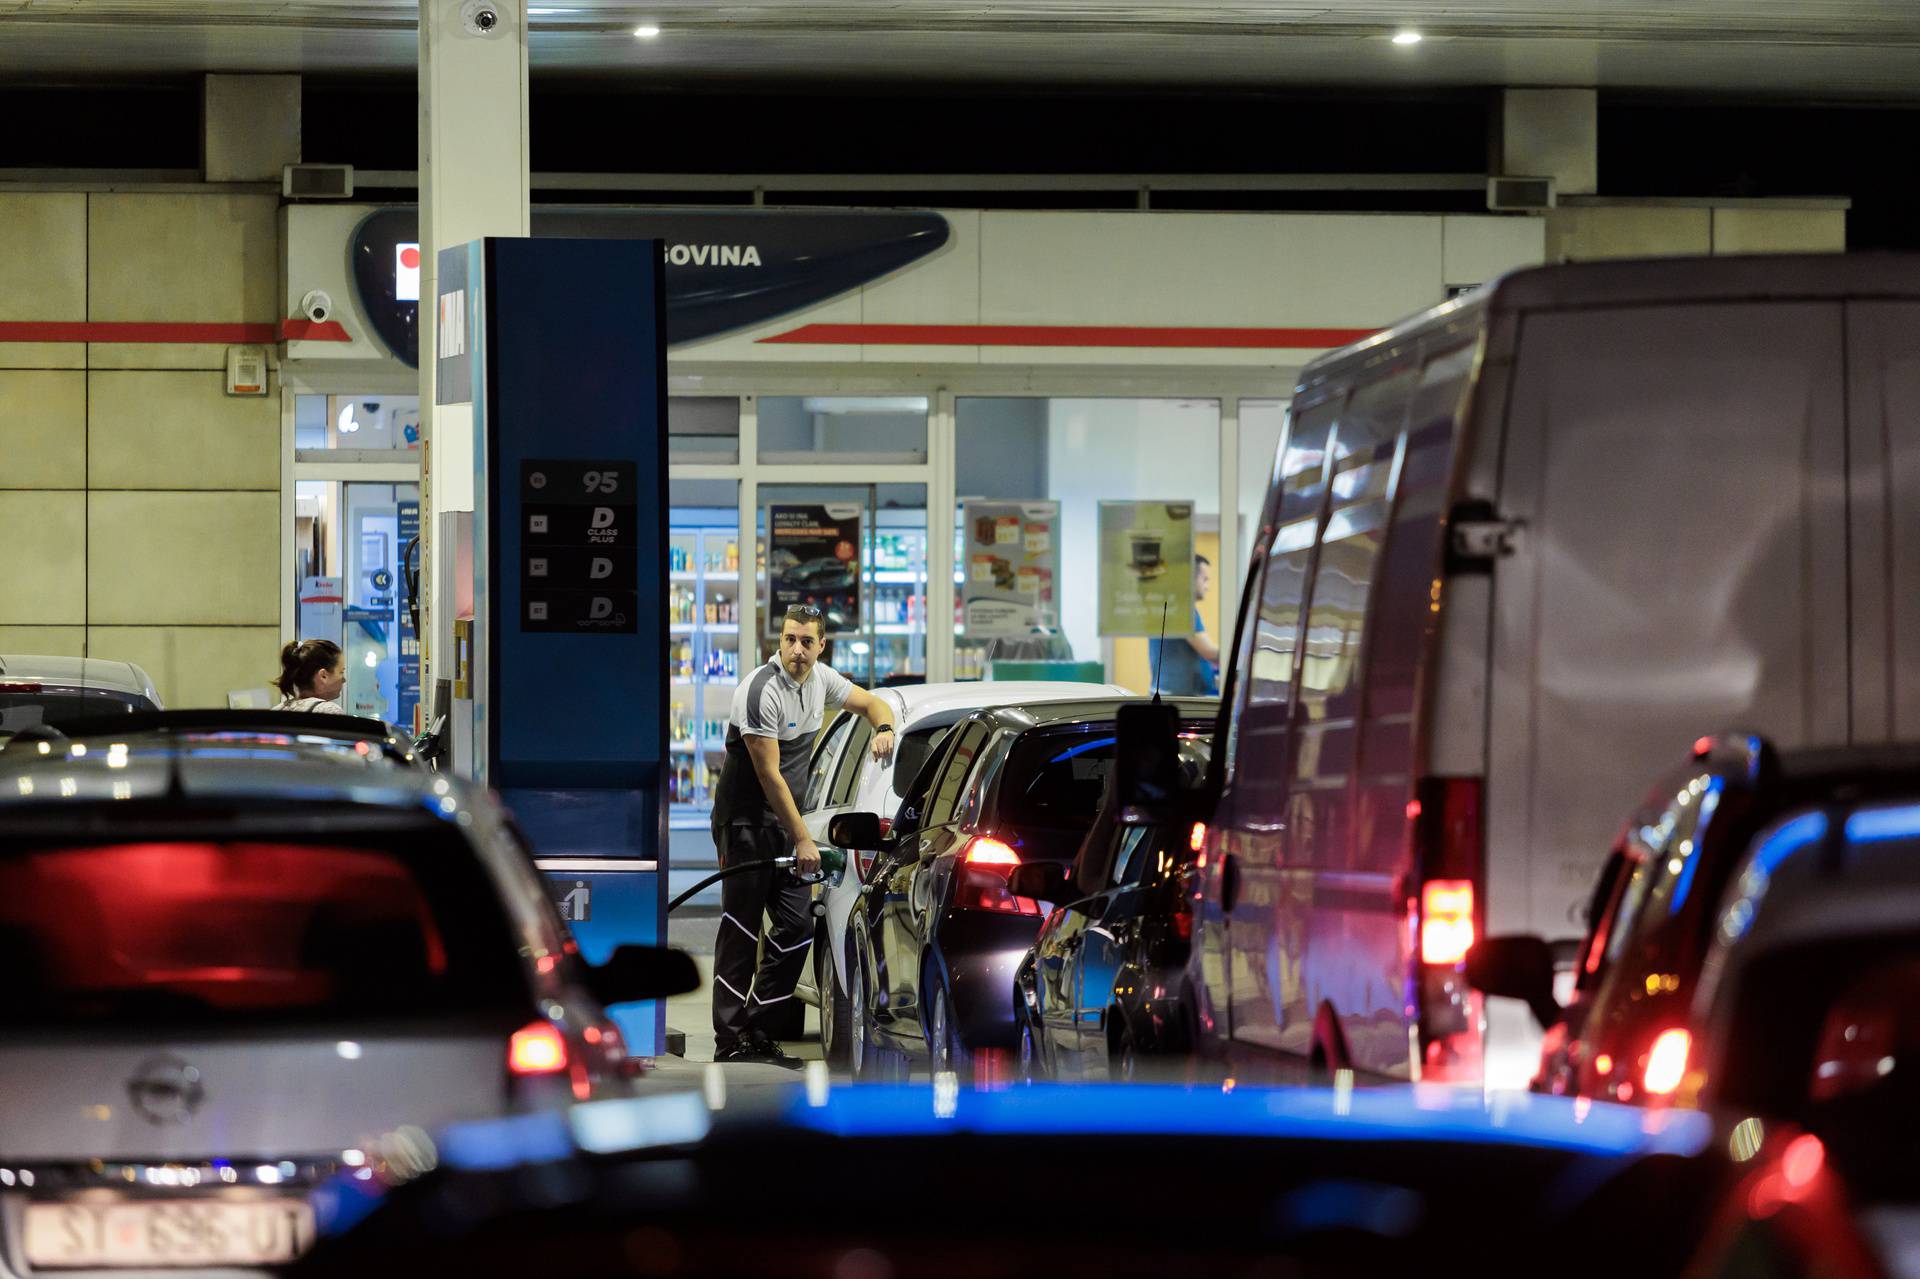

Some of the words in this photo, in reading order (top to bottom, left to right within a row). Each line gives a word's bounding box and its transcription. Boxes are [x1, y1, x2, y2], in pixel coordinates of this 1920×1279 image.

[583, 471, 619, 493] 95
[591, 506, 615, 529] D
[587, 528, 618, 536] CLASS
[590, 557, 613, 579] D
[589, 597, 613, 619] D
